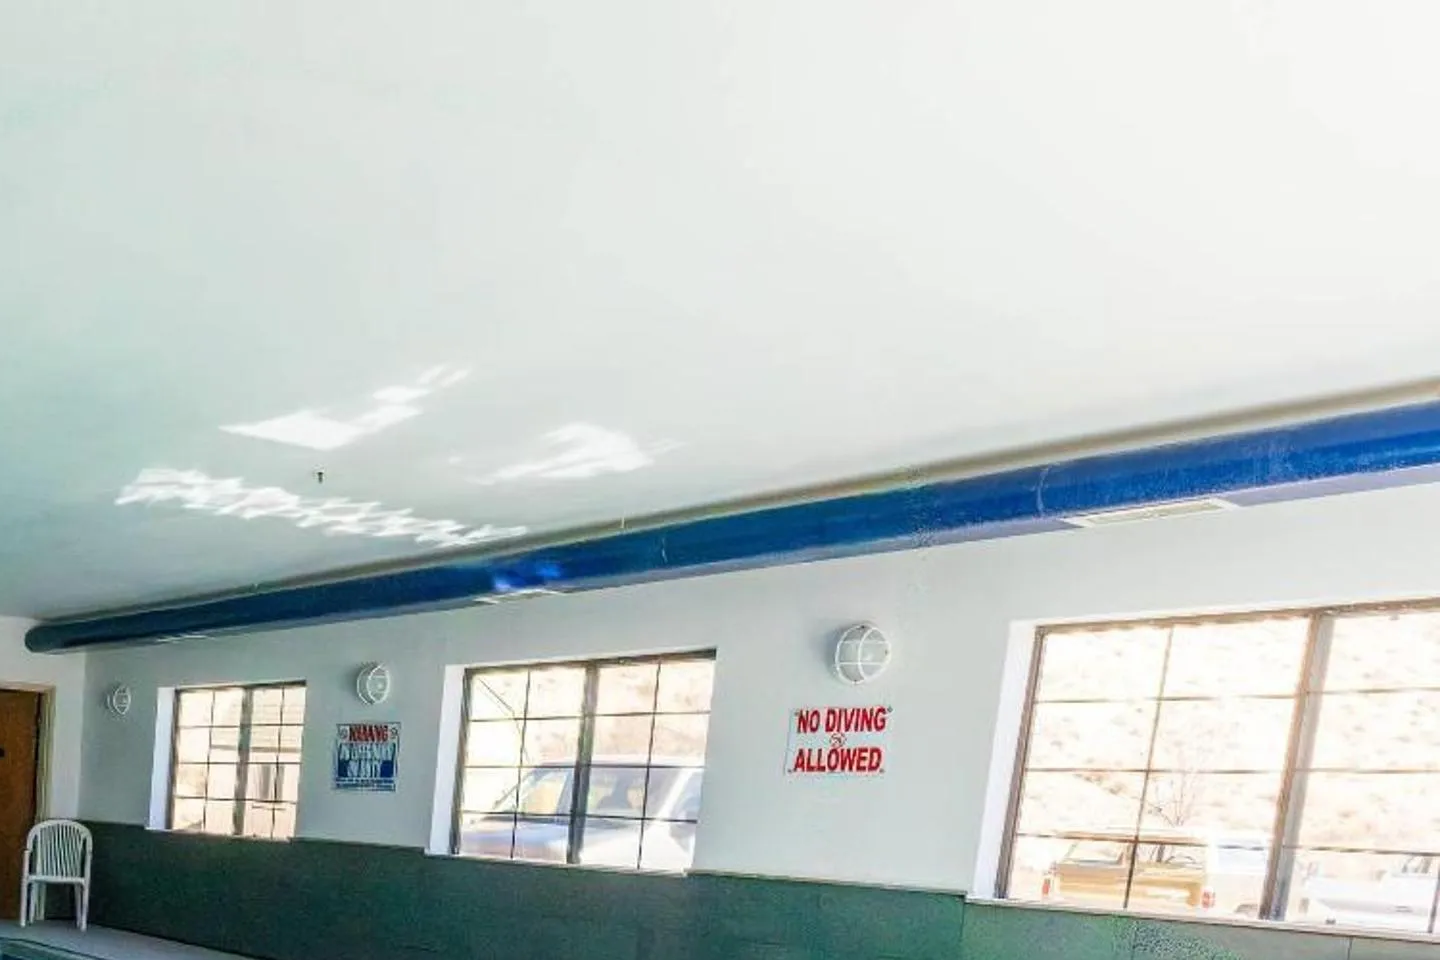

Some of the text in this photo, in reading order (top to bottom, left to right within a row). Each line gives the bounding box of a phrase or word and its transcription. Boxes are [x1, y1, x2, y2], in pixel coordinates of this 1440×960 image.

[797, 706, 886, 733] NO DIVING
[793, 747, 882, 772] ALLOWED
